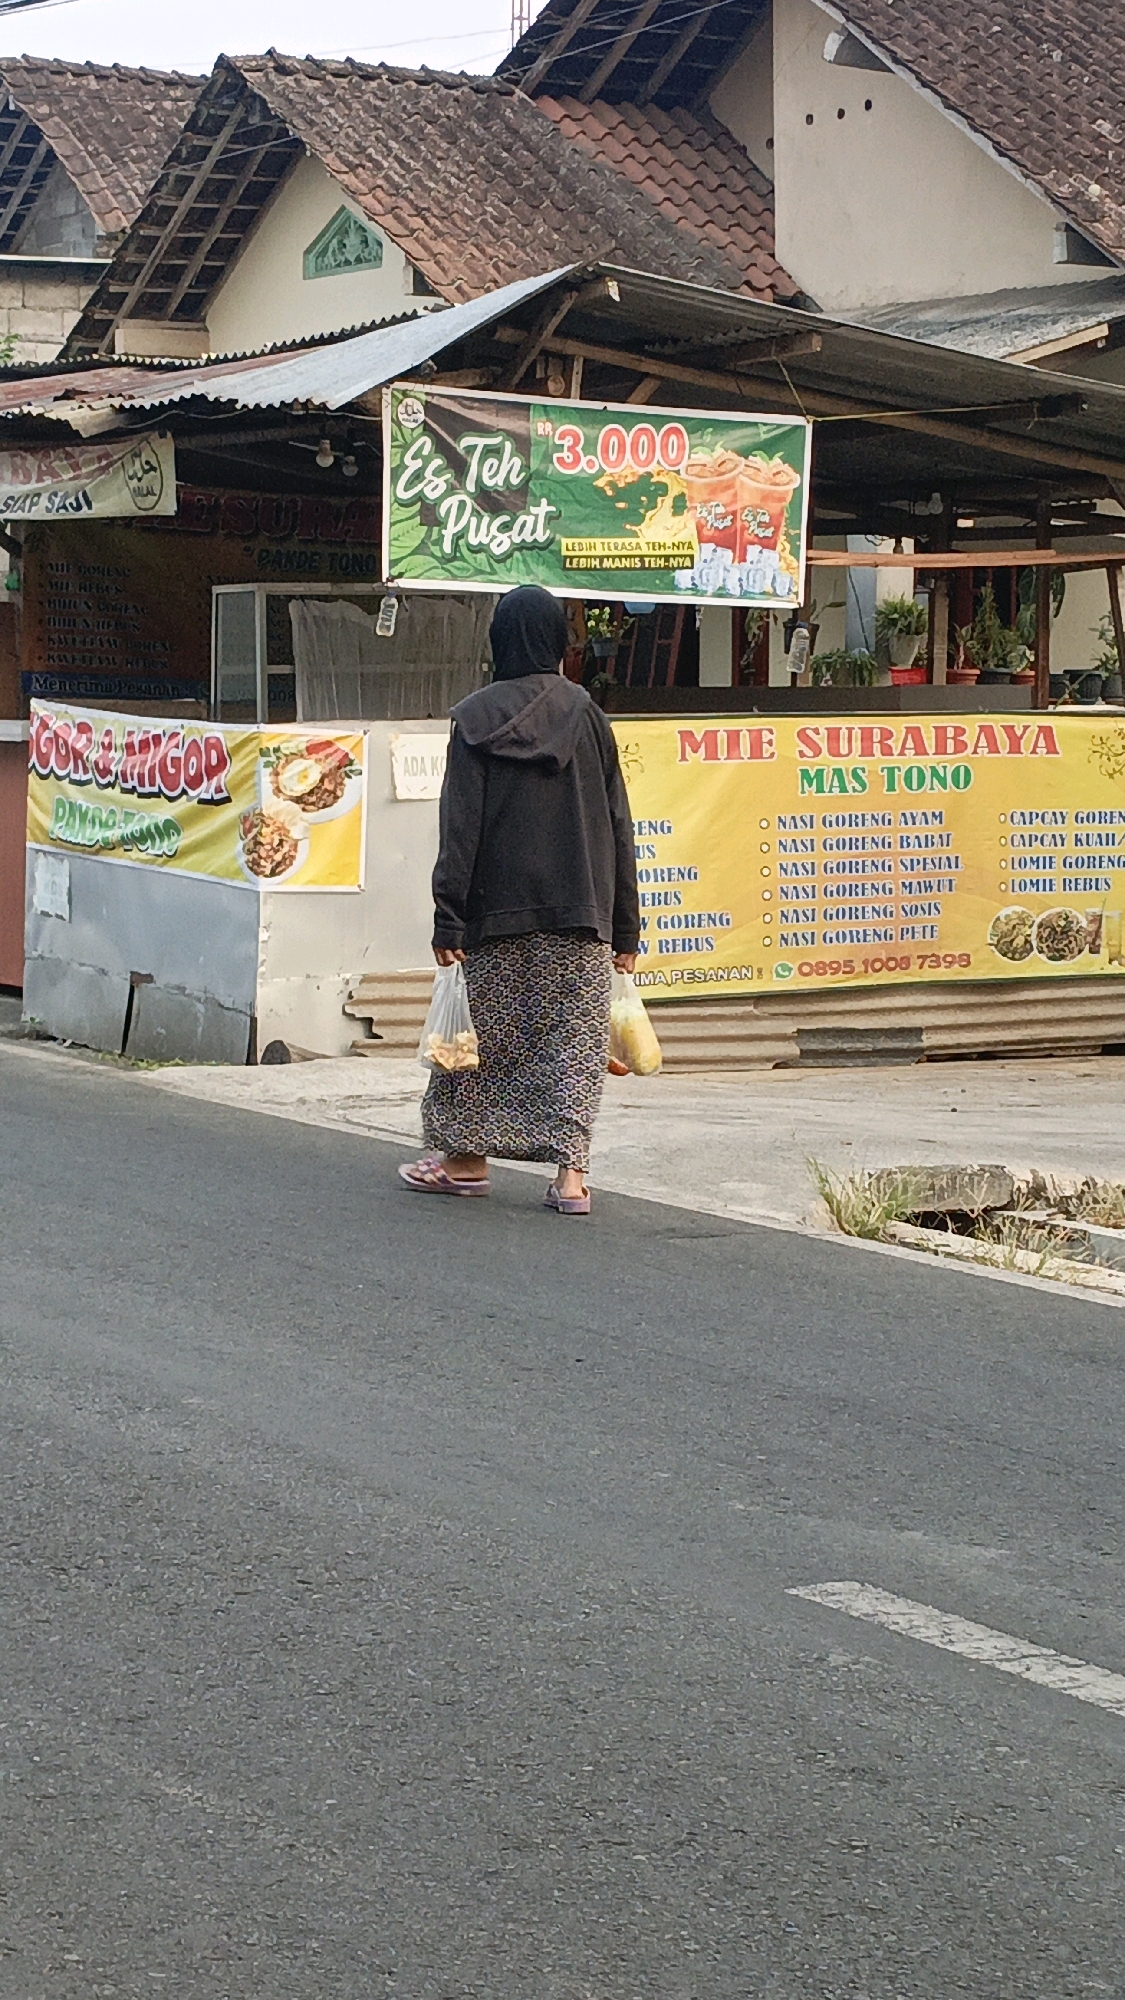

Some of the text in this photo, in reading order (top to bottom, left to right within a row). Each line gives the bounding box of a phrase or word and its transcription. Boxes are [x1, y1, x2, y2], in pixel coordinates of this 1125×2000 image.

[553, 423, 689, 474] 3.000
[396, 436, 526, 500] Es Teh
[0, 493, 42, 514] SIAP
[440, 494, 557, 554] Pusat
[565, 541, 597, 552] LEBIH
[600, 541, 642, 551] TERASA
[565, 557, 600, 569] LEBIH
[602, 557, 642, 568] MANIS
[677, 725, 1061, 763] MIE SURABAYA
[403, 755, 428, 777] ADA
[800, 764, 973, 795] MAS TONO
[633, 819, 672, 836] ENG
[777, 811, 943, 830] NASI GORENG AYAM
[1009, 810, 1069, 826] CAPCAY
[778, 833, 953, 854] NASI GORENG BABAT
[1010, 832, 1067, 848] CAPCAY
[778, 856, 964, 877] NASI GORENG SPESIAL
[1010, 855, 1057, 870] LOMIE
[637, 866, 698, 884] ORENG
[1010, 877, 1111, 893] LOMIE REBUS
[640, 890, 682, 908] EBUS
[780, 879, 957, 900] NASI GORENG MAWUT
[656, 912, 731, 931] GORENG
[780, 902, 942, 924] NASI GORENG SOSIS
[658, 936, 714, 954] REBUS
[779, 925, 939, 947] NASI GORENG PETE
[671, 965, 753, 984] PESANAN
[798, 960, 856, 977] 0895
[917, 953, 972, 970] 7398
